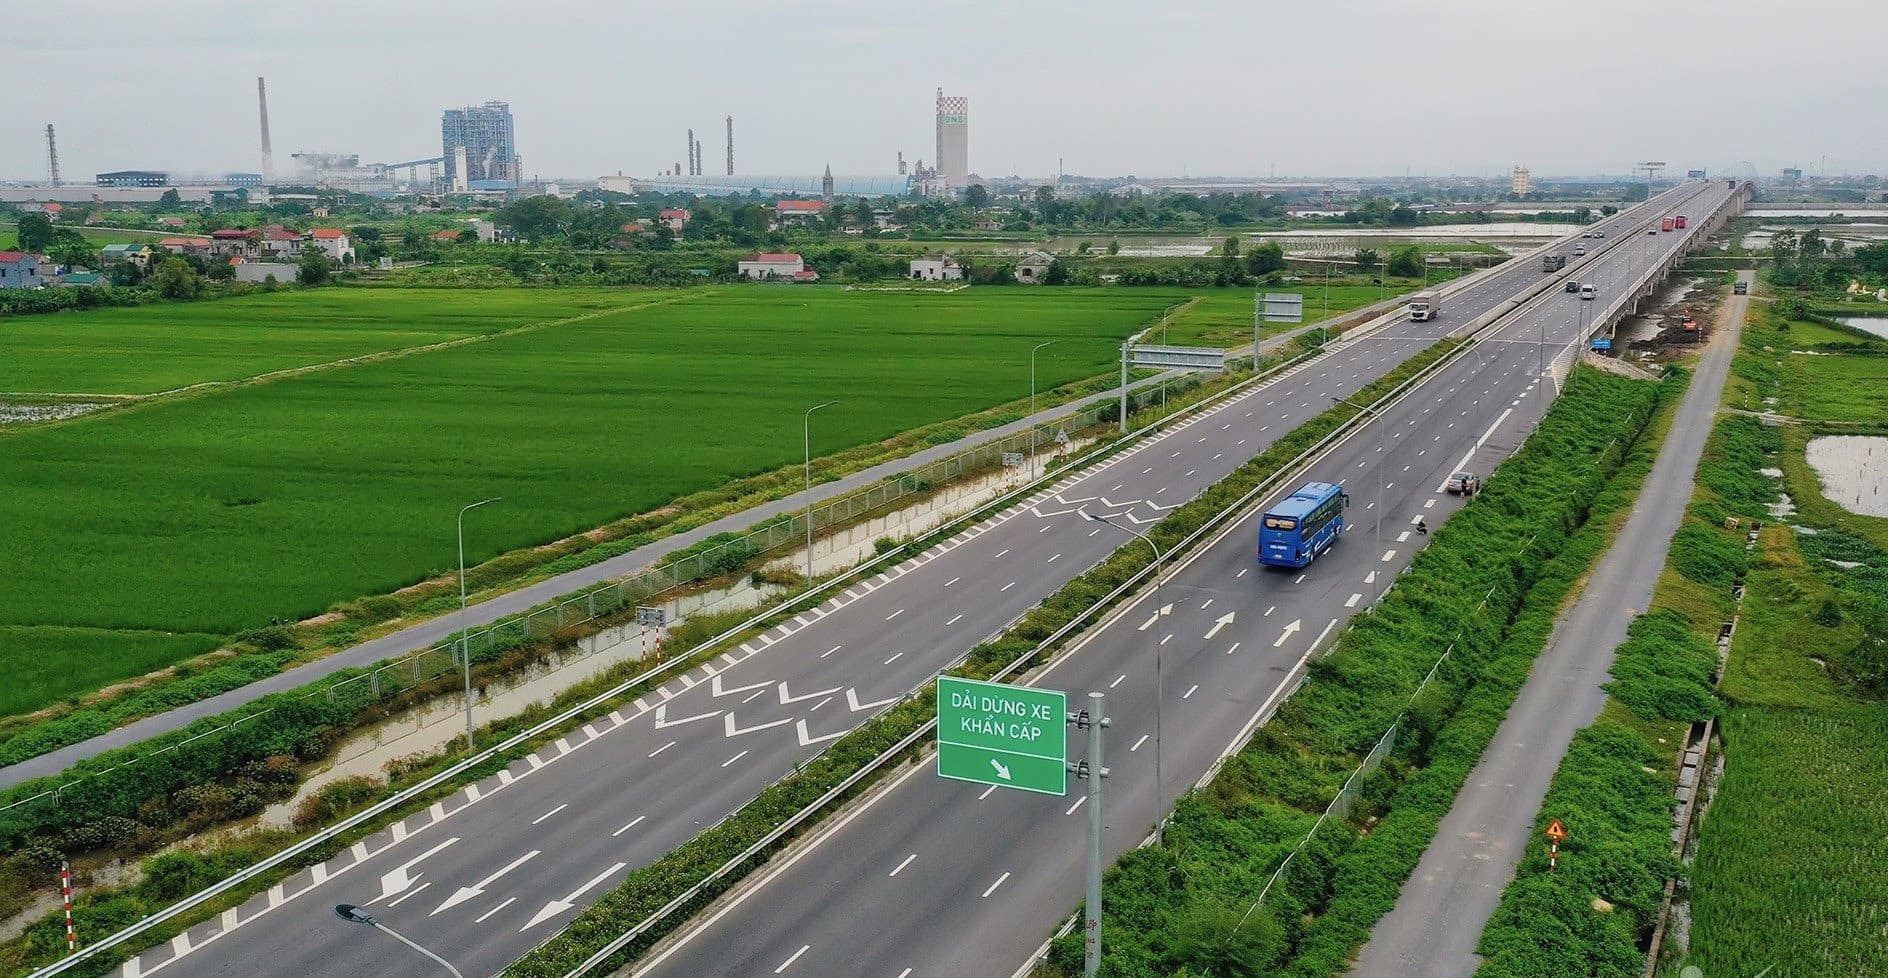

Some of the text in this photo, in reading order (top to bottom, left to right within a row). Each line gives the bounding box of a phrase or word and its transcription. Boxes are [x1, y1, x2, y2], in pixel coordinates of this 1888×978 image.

[951, 690, 1051, 720] DẢI DỪNG XE
[961, 715, 1042, 741] KHẨN CẤP
